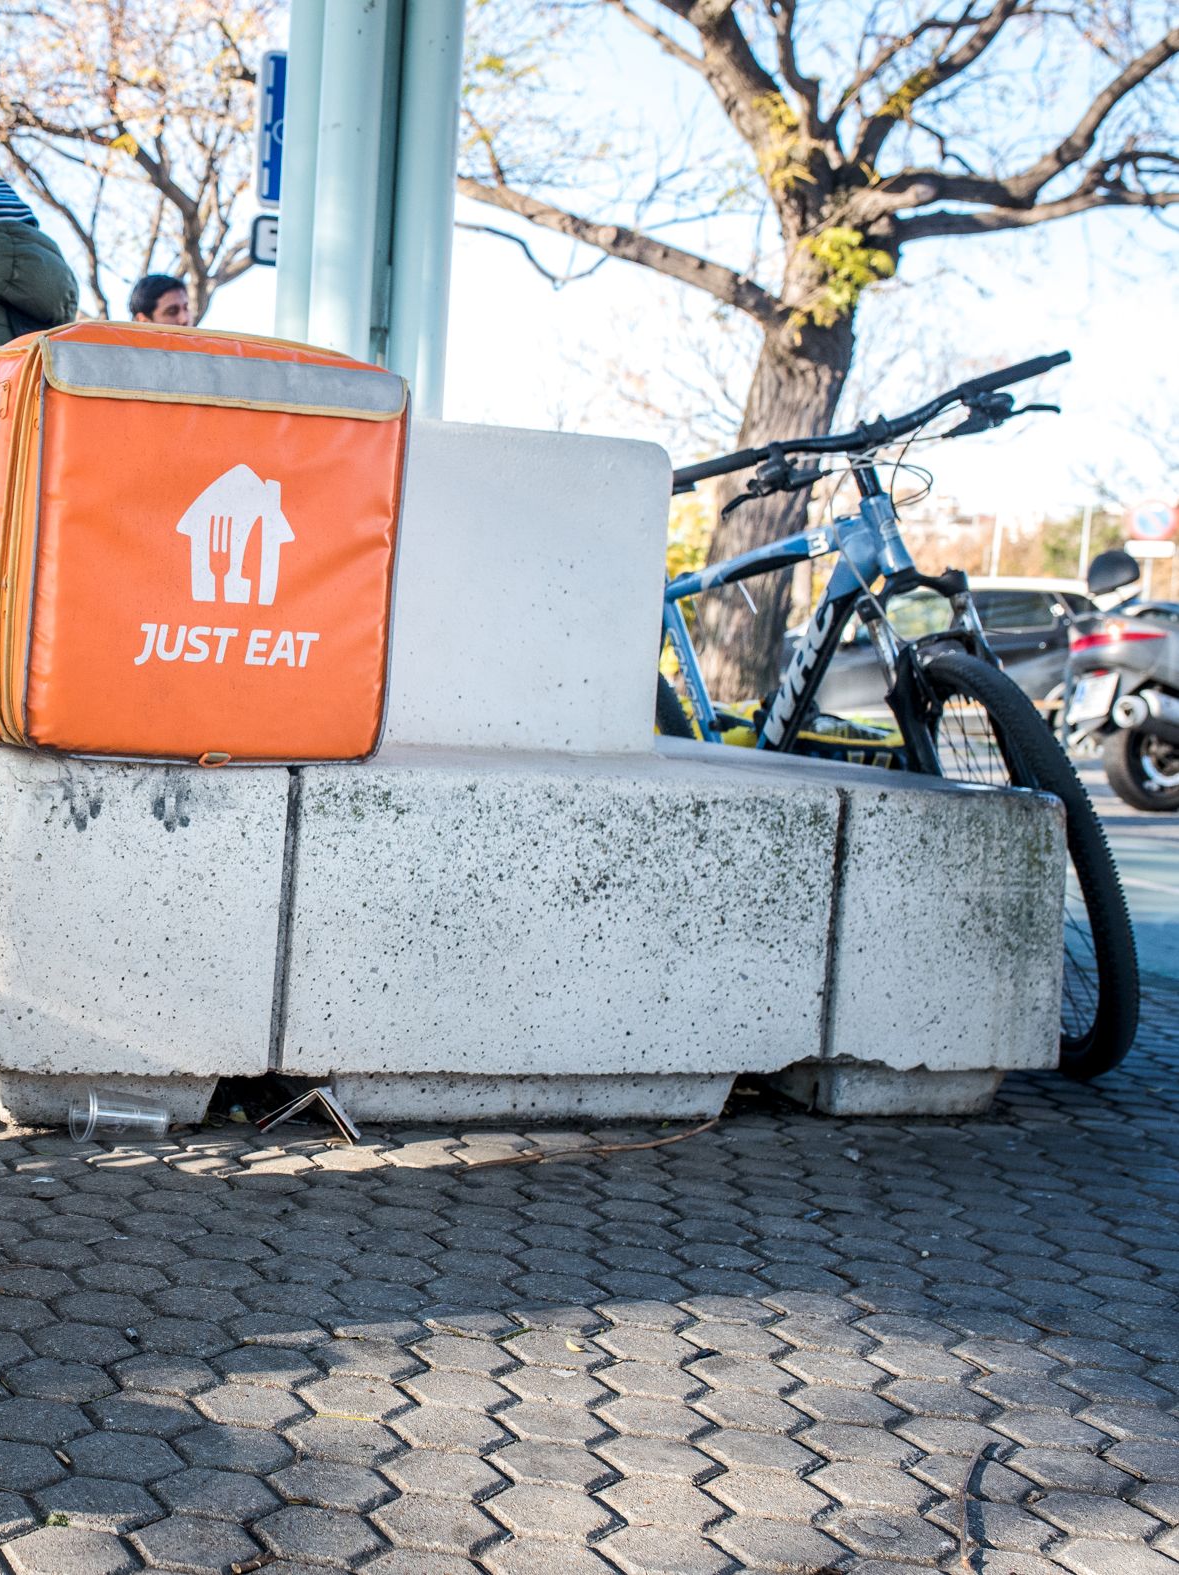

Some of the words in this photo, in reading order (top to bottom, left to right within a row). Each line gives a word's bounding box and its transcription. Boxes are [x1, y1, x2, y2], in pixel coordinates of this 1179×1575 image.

[133, 622, 239, 666] JUST
[244, 629, 320, 668] EAT
[763, 588, 834, 747] WRC
